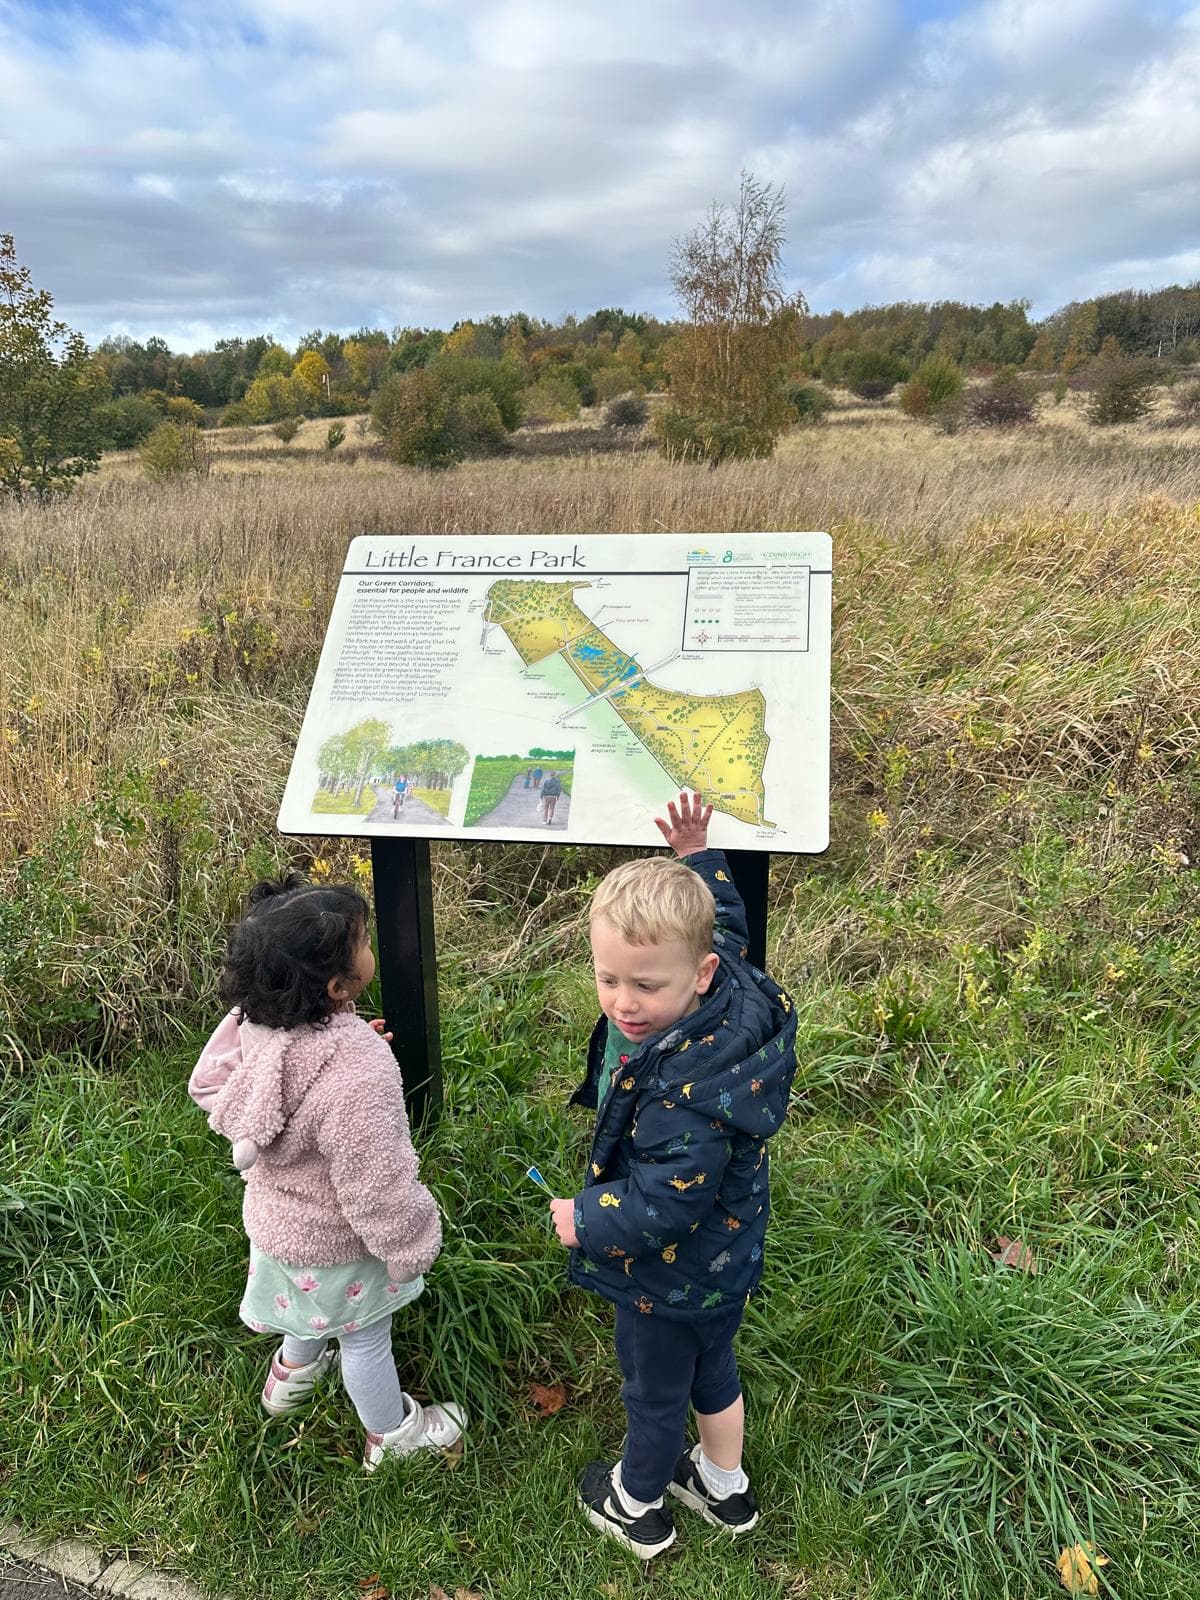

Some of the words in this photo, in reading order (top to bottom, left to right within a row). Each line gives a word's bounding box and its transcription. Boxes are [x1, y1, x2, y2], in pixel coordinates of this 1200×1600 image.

[365, 545, 428, 568] Little
[435, 550, 521, 568] France
[529, 544, 587, 568] Park
